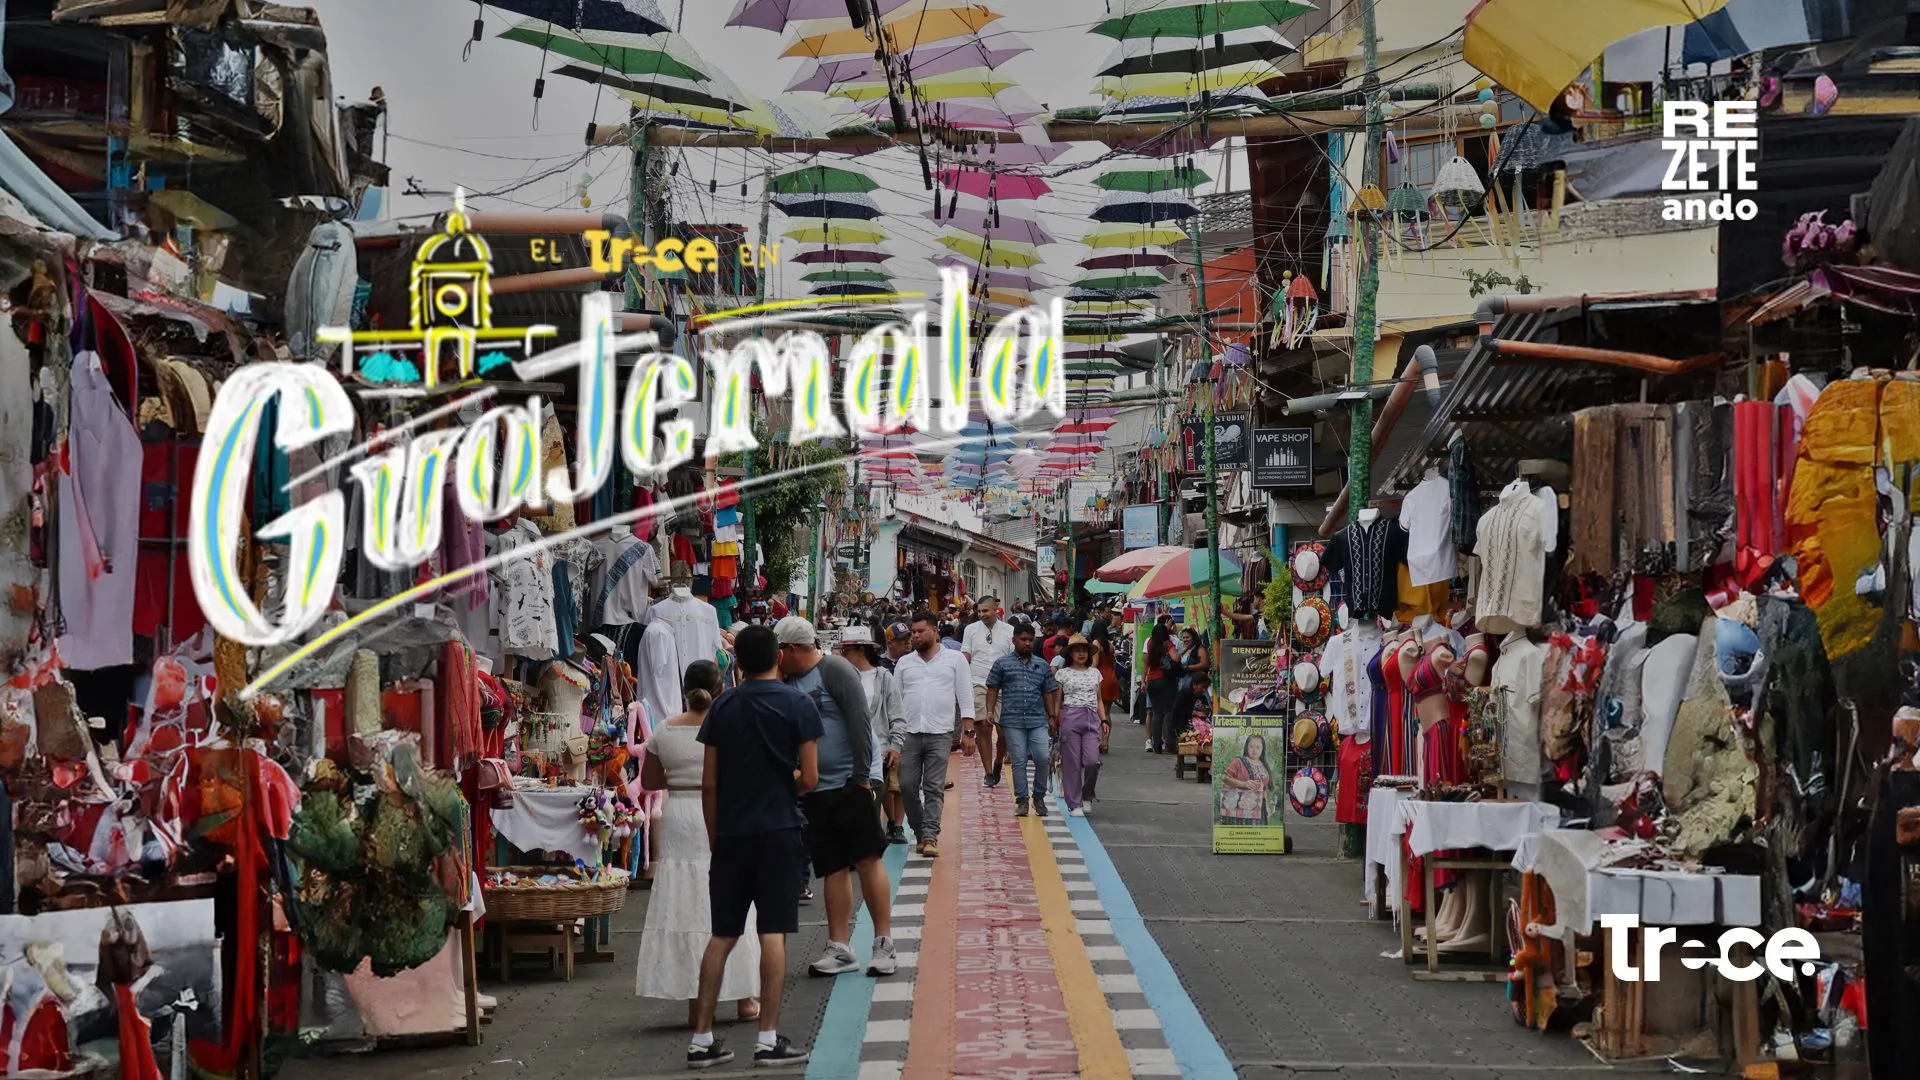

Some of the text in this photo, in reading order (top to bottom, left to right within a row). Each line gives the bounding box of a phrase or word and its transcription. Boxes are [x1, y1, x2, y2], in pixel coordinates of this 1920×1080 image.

[1256, 433, 1309, 442] VAPE SHOP
[1251, 716, 1283, 726] Hermanos
